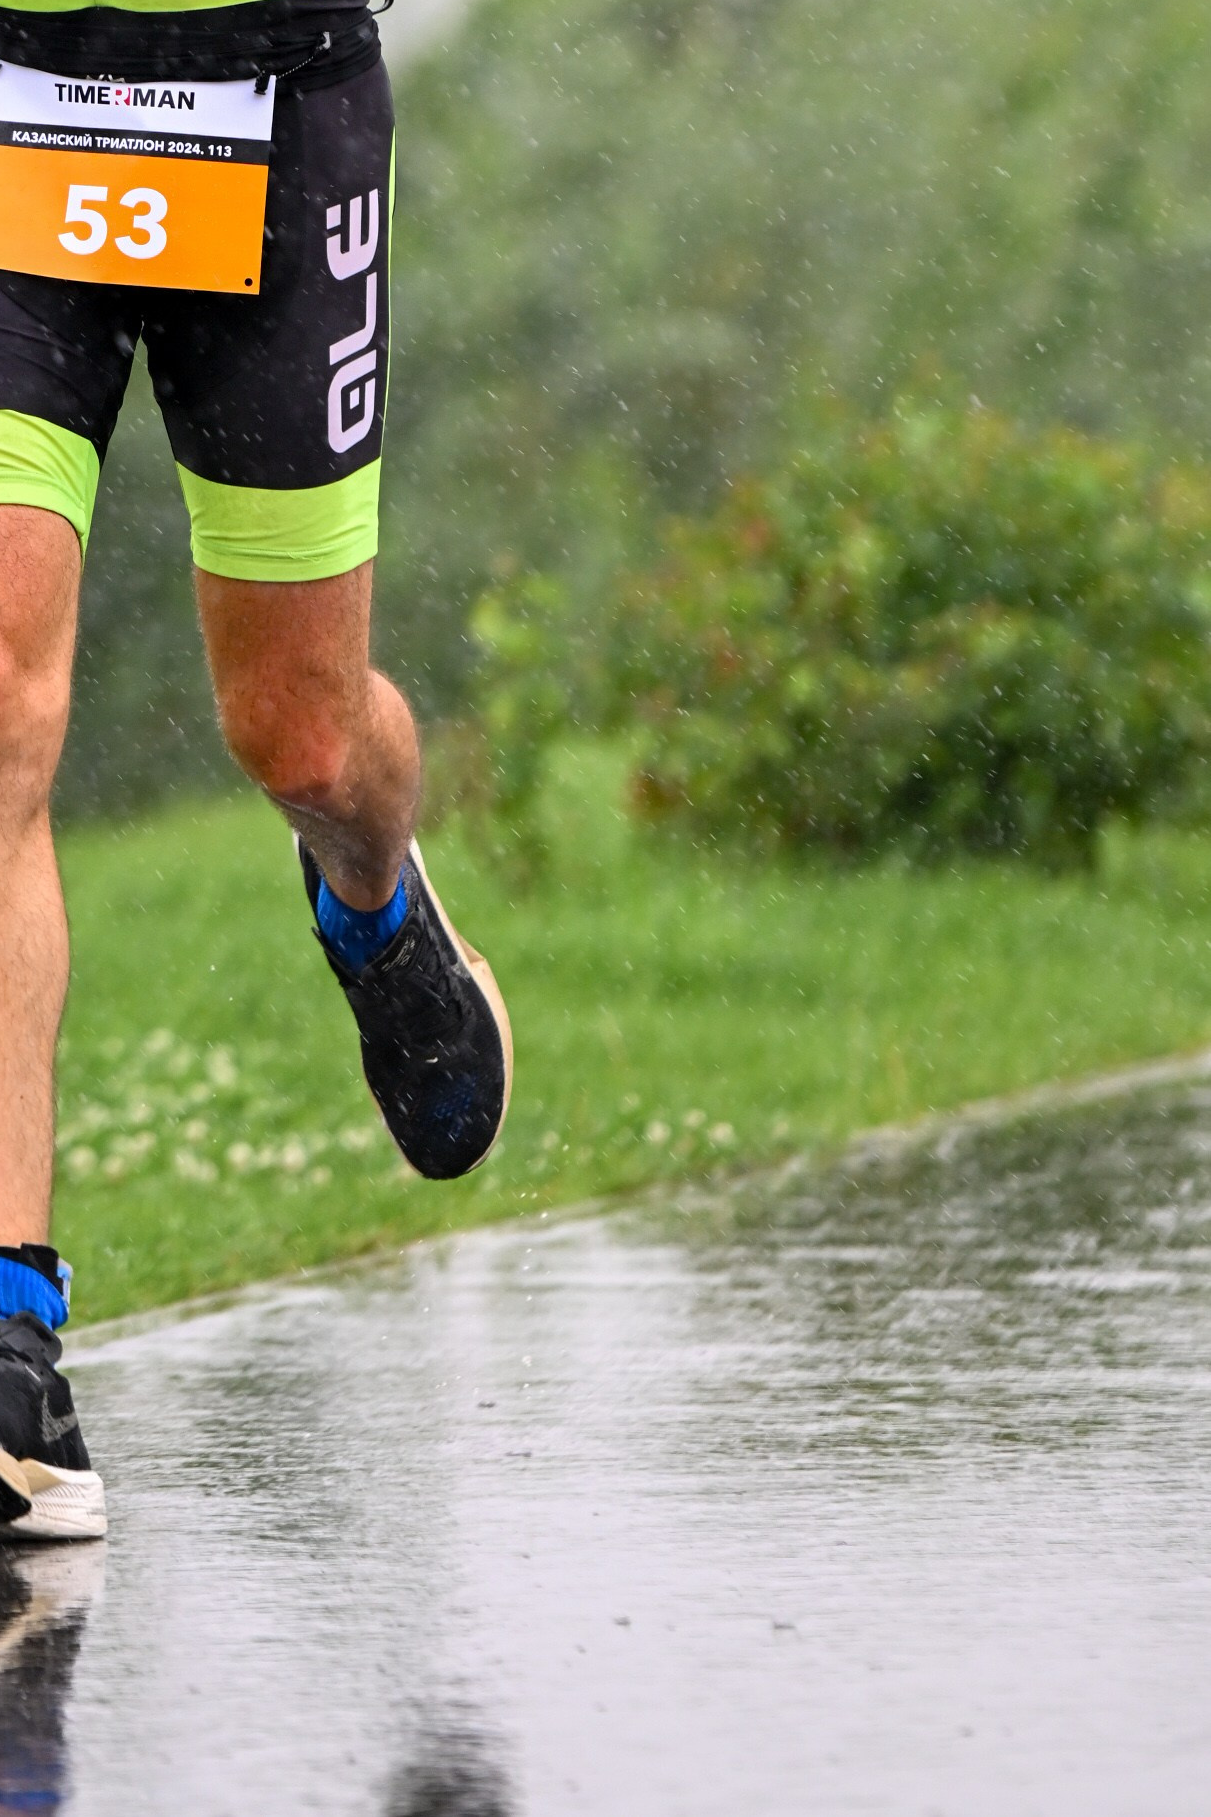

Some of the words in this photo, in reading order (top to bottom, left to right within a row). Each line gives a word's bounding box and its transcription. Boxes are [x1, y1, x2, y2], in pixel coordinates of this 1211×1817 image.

[12, 130, 93, 148] КАЗАНСКИЙ
[95, 136, 165, 152] ТРИАТЛОН
[167, 141, 205, 156] 2024.
[208, 144, 232, 157] 113
[58, 184, 168, 260] 53
